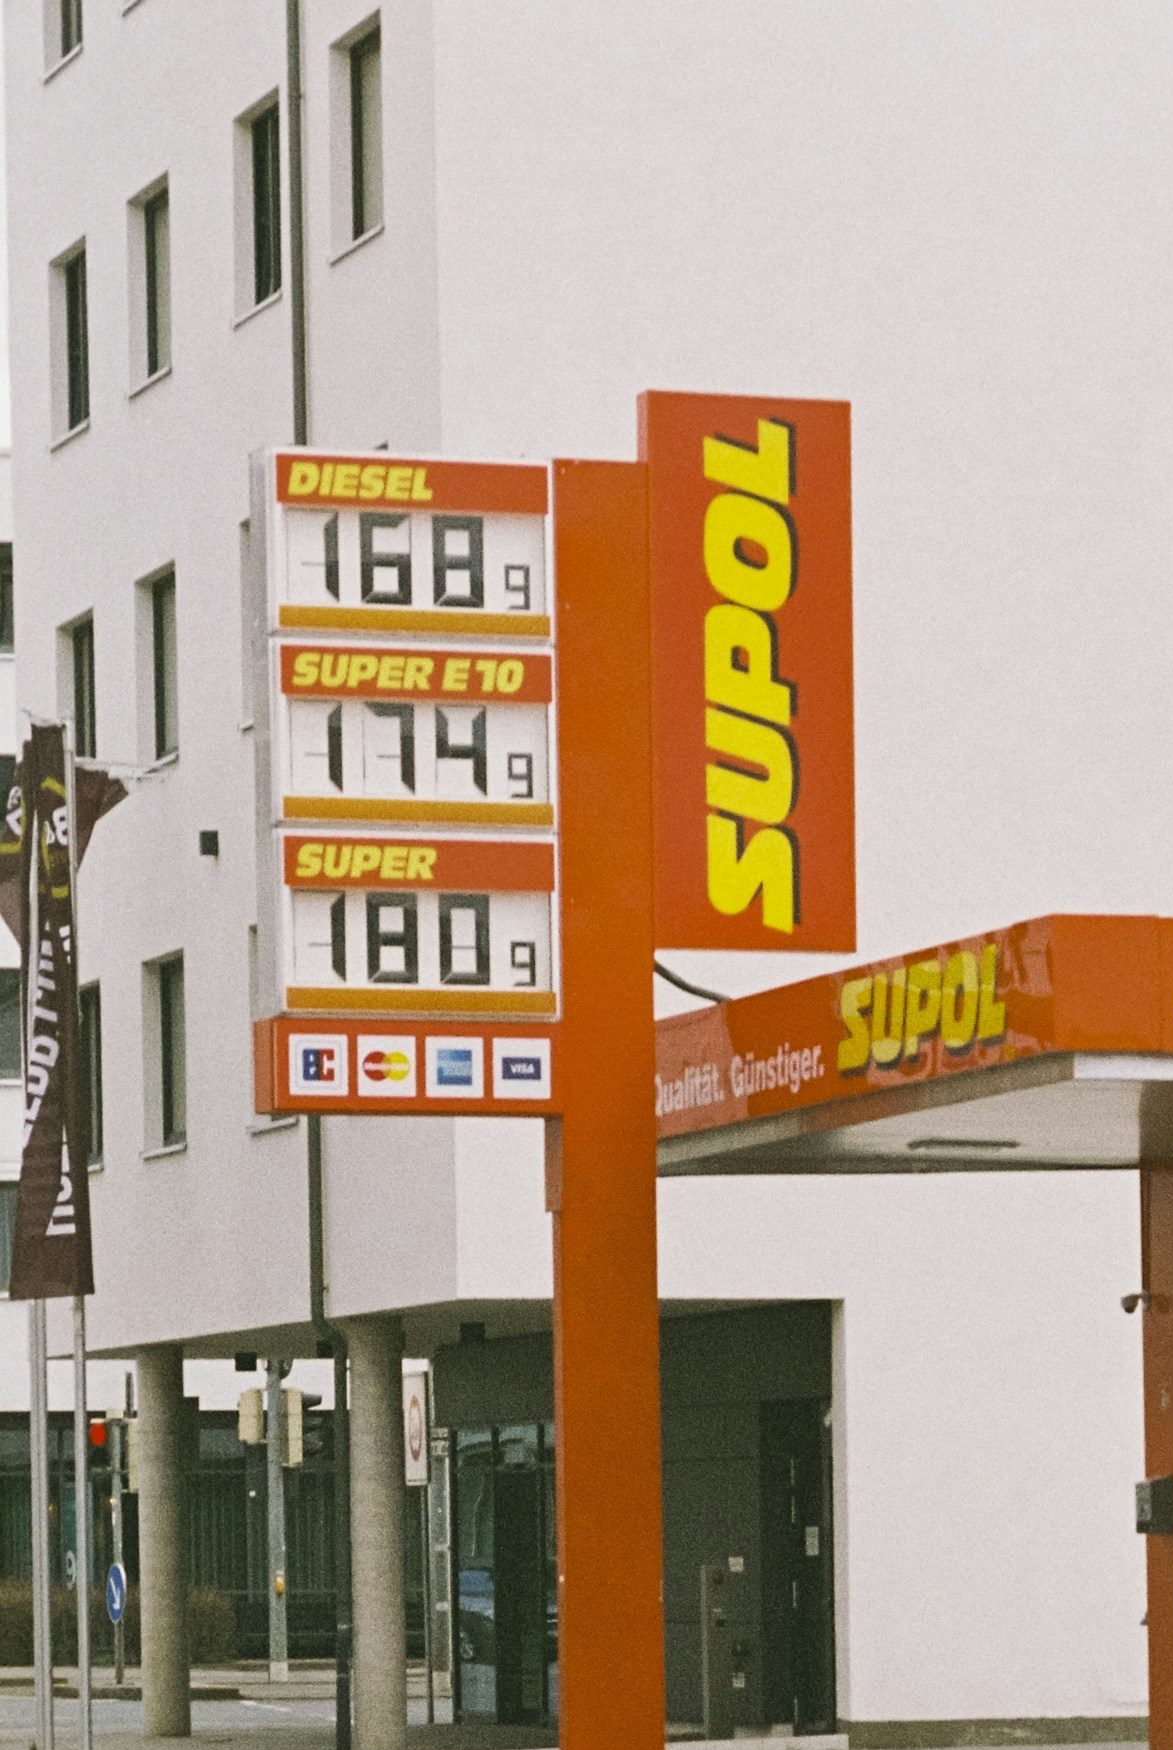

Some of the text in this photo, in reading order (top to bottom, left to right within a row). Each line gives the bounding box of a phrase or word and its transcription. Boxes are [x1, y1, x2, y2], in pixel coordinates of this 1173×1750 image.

[287, 460, 433, 501] DIESEL
[292, 651, 435, 692] SUPER
[703, 418, 797, 935] SUPOL
[295, 842, 438, 881] SUPER
[837, 943, 1006, 1076] SUPOL
[510, 1062, 535, 1075] VISA
[730, 1041, 826, 1097] Günstiger.
